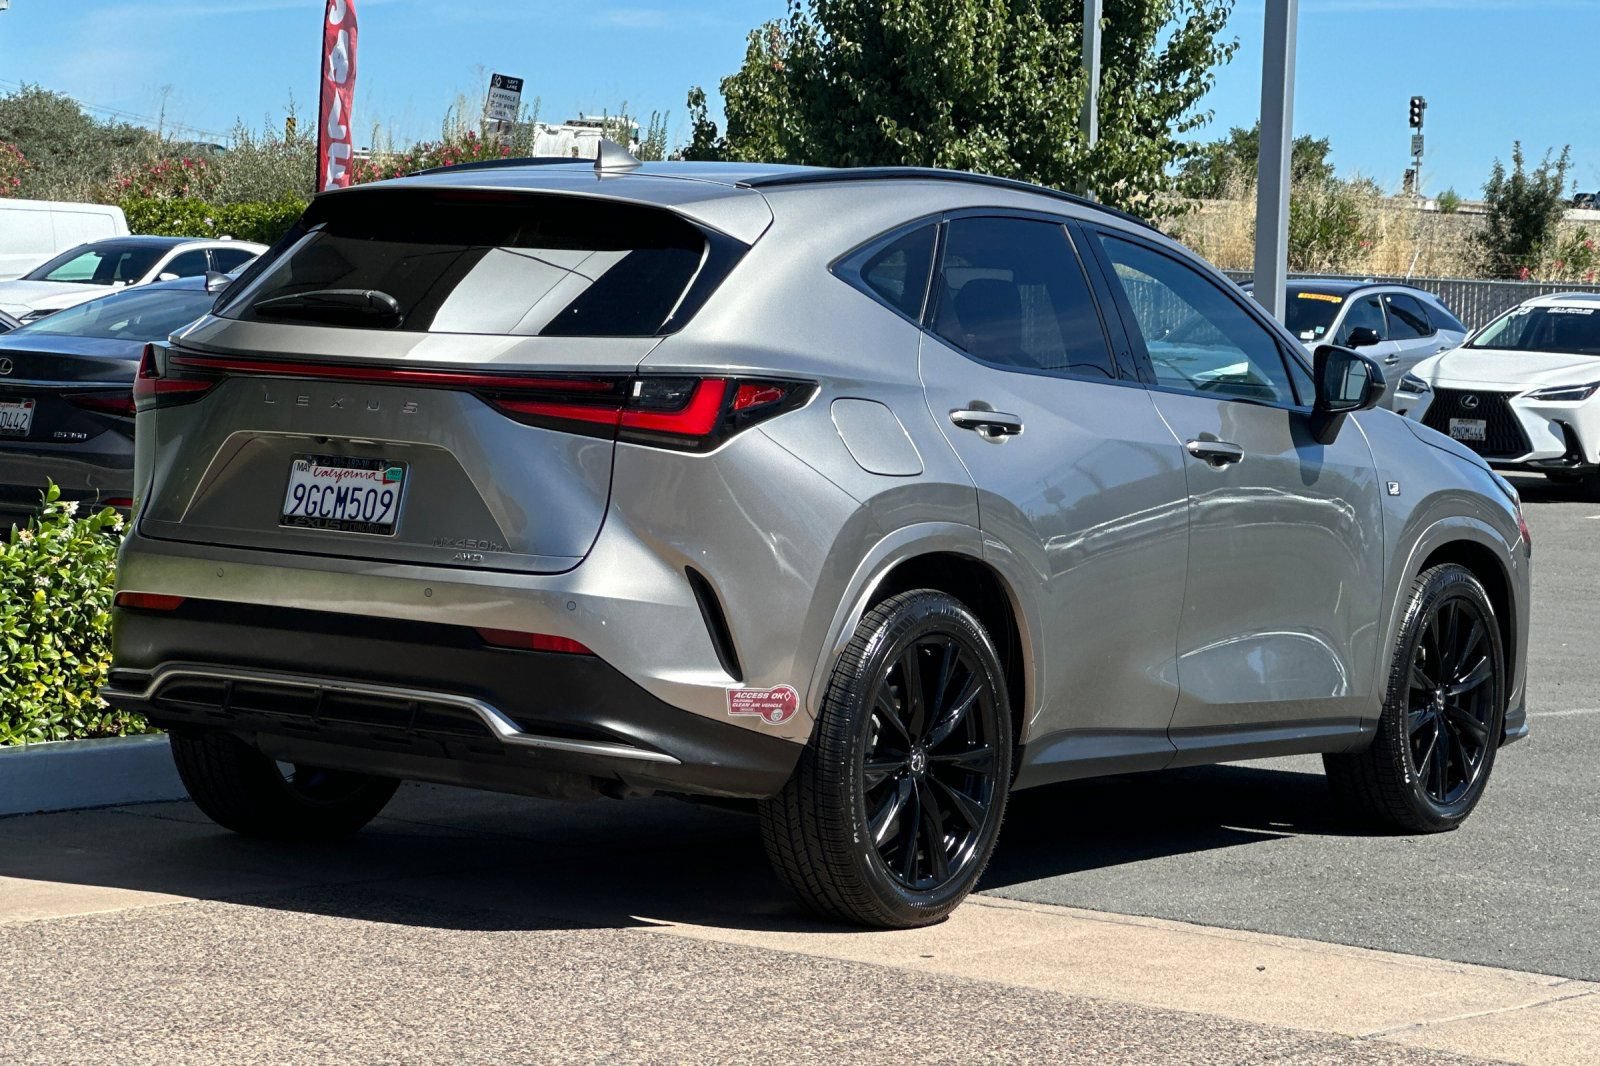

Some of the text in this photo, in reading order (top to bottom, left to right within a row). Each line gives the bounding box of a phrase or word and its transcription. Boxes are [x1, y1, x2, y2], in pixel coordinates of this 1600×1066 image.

[264, 392, 419, 414] LEXUS
[0, 411, 28, 430] D442
[296, 462, 311, 473] MAY
[313, 466, 382, 484] California
[289, 483, 394, 523] 9GCM509
[452, 552, 485, 561] AWD
[771, 692, 784, 700] OK
